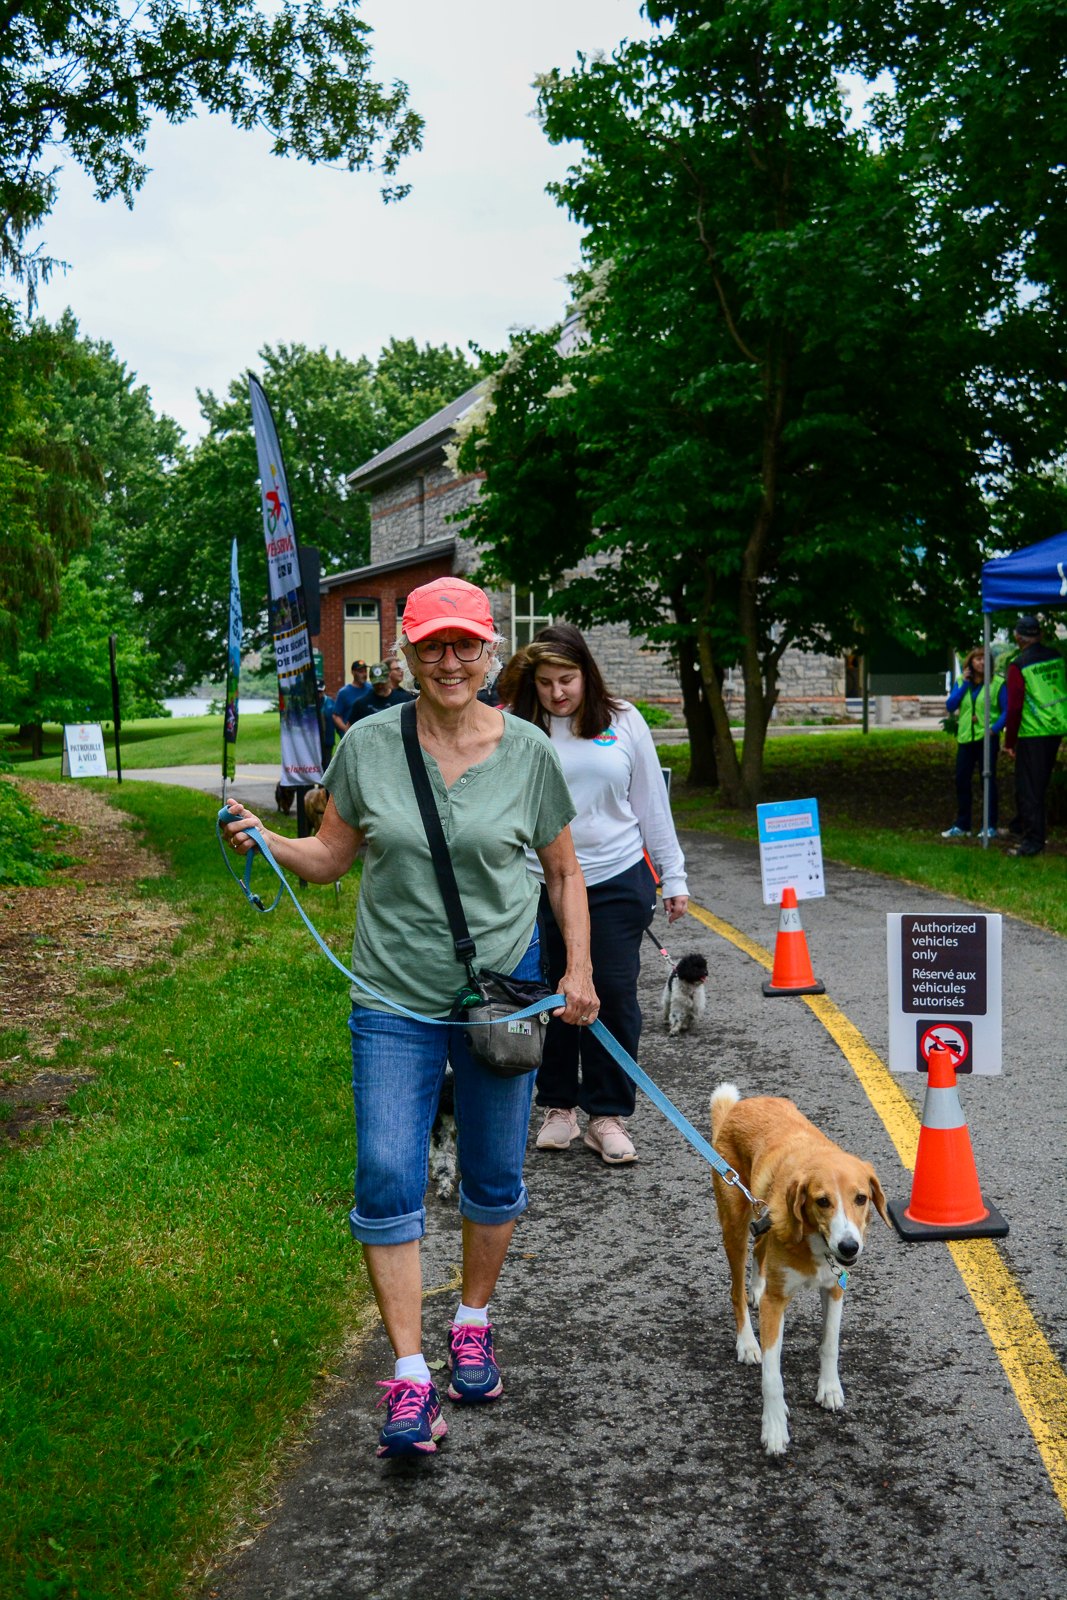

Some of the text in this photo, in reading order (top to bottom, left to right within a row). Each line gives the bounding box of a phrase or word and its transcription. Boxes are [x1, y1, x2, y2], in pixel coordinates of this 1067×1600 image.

[70, 744, 102, 752] PATROUILLE
[84, 752, 97, 762] VÉLO
[912, 922, 976, 934] Authorized
[912, 936, 959, 947] vehicles
[912, 949, 938, 962] only
[912, 968, 977, 981] Réservé aux
[912, 982, 966, 994] véhicules
[912, 996, 965, 1007] autorisés
